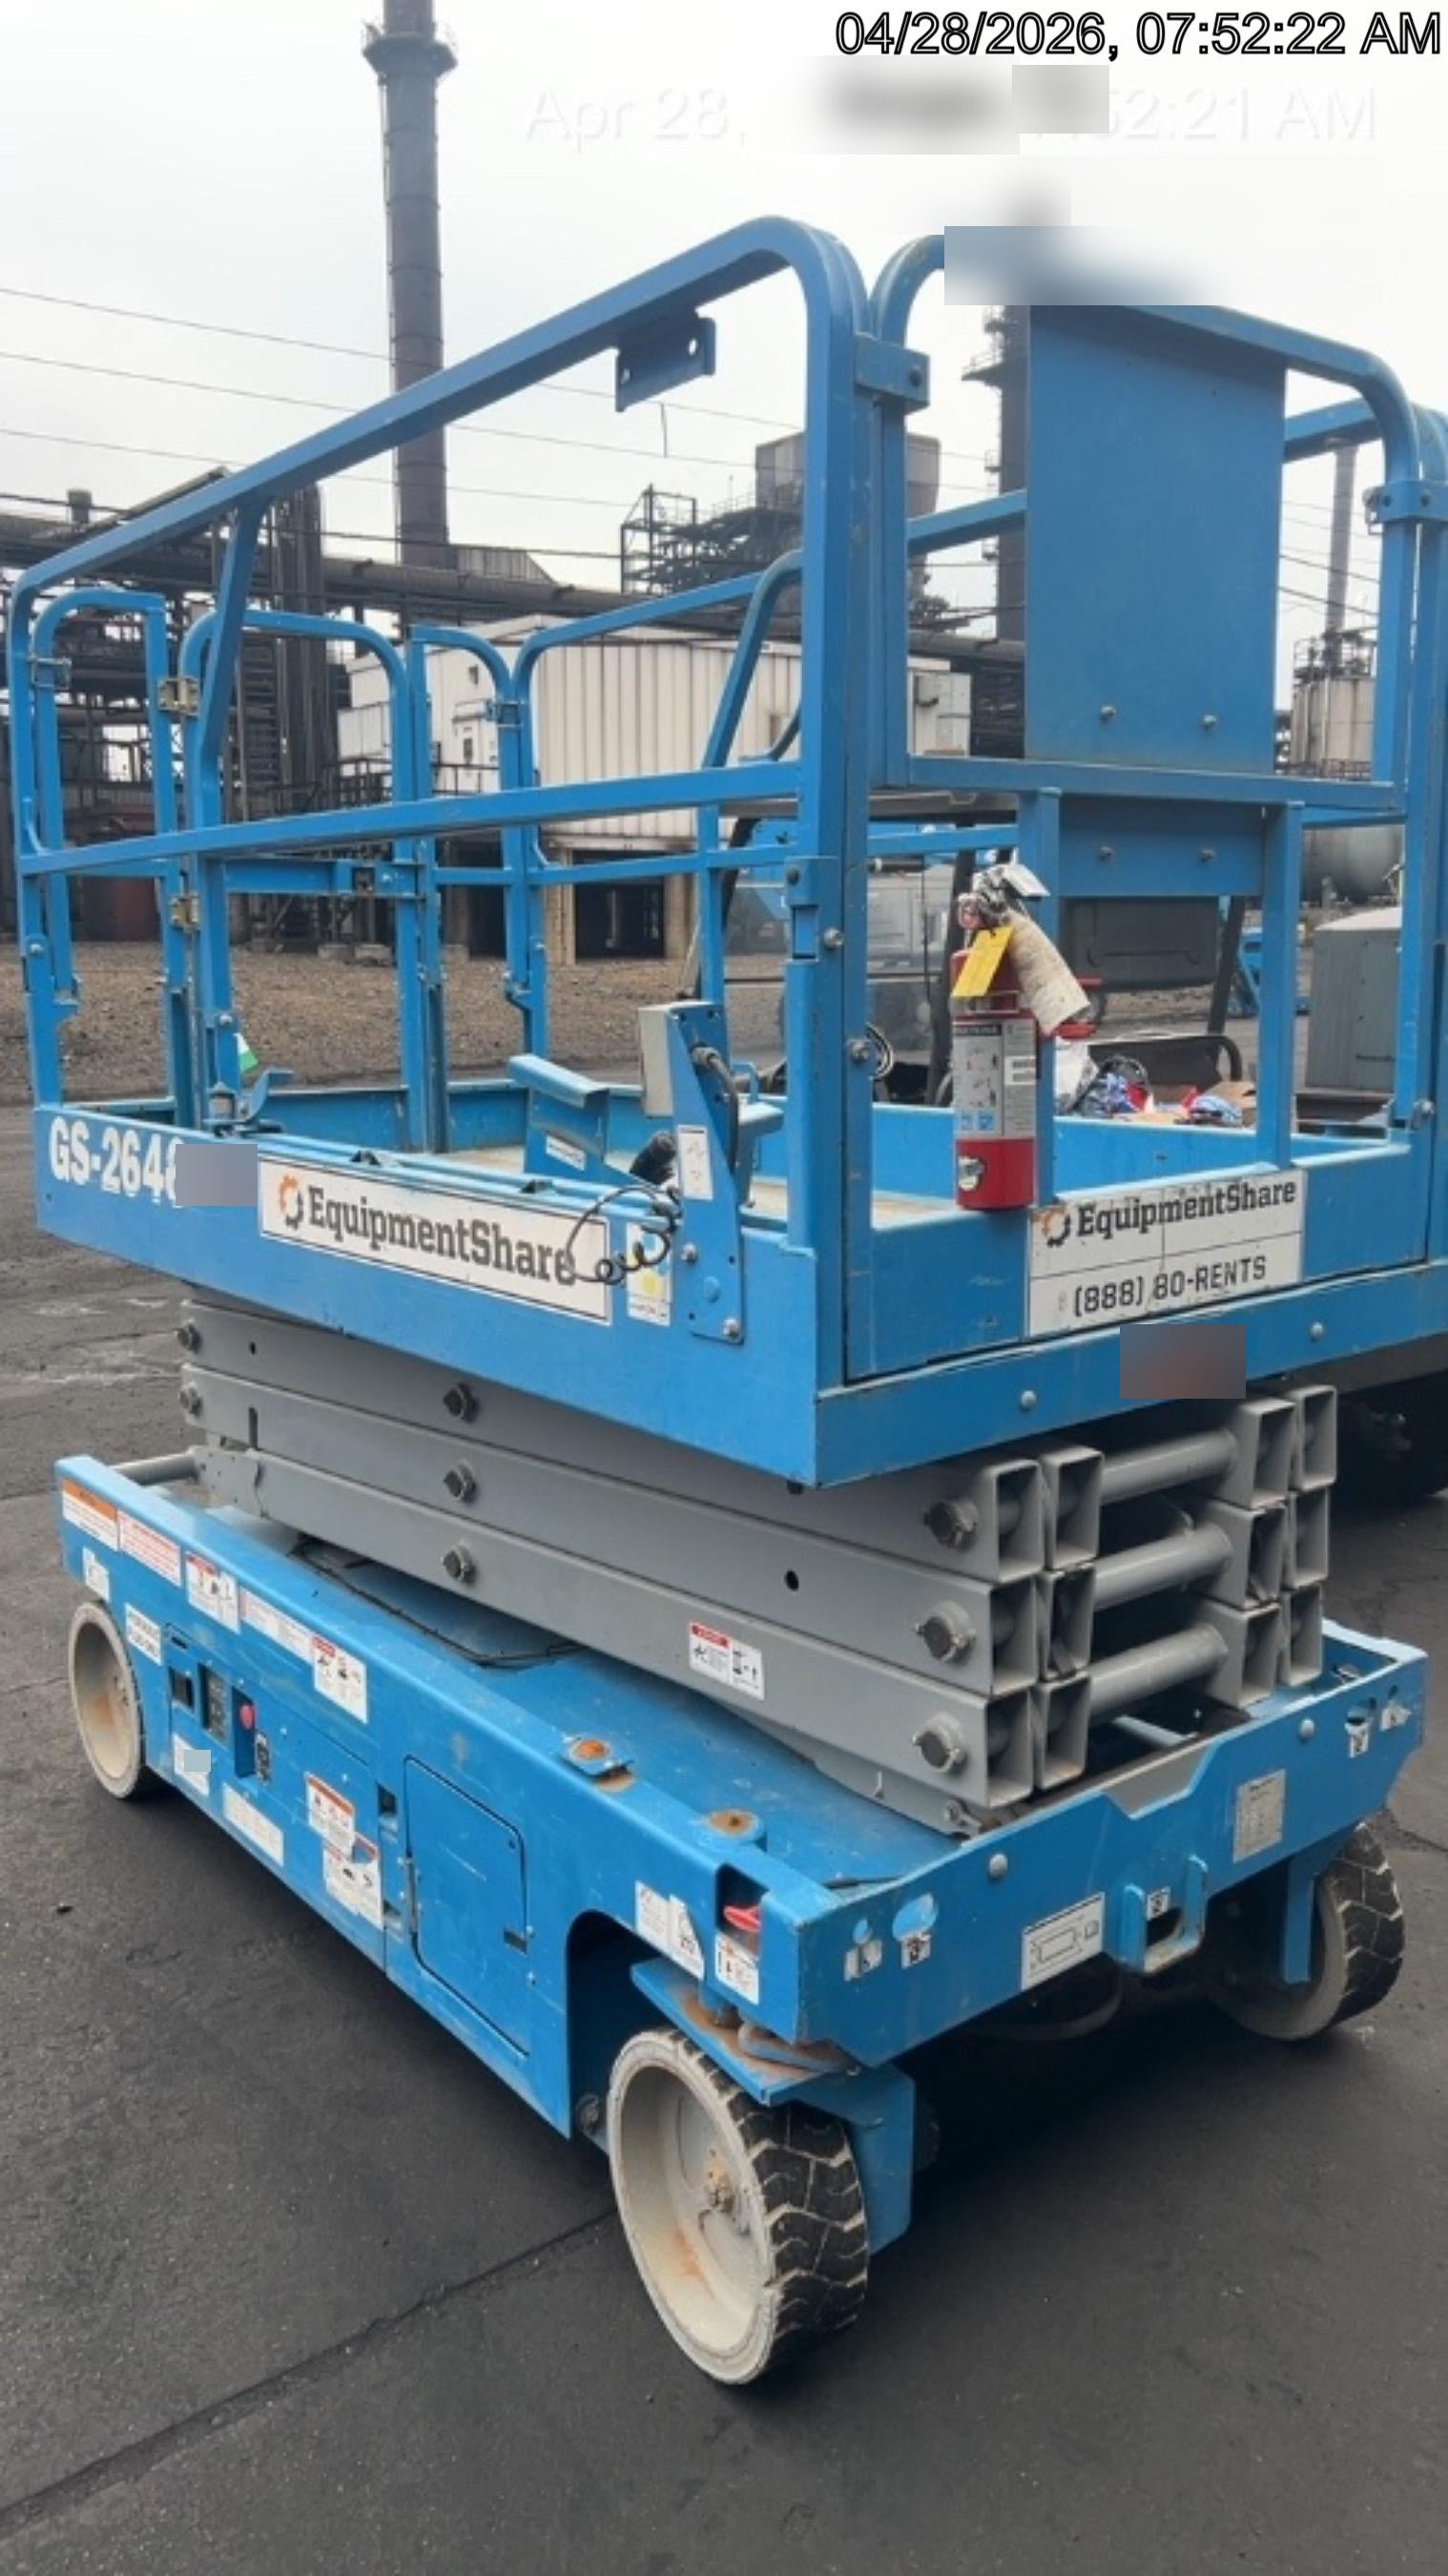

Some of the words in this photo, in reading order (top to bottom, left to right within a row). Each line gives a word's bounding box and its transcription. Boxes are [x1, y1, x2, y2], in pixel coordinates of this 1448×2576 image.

[307, 1185, 576, 1286] EquipmentShare
[1076, 1181, 1297, 1239] EquipmentShare
[1074, 1276, 1144, 1318] (888)
[1152, 1256, 1267, 1300] 80-RENTS
